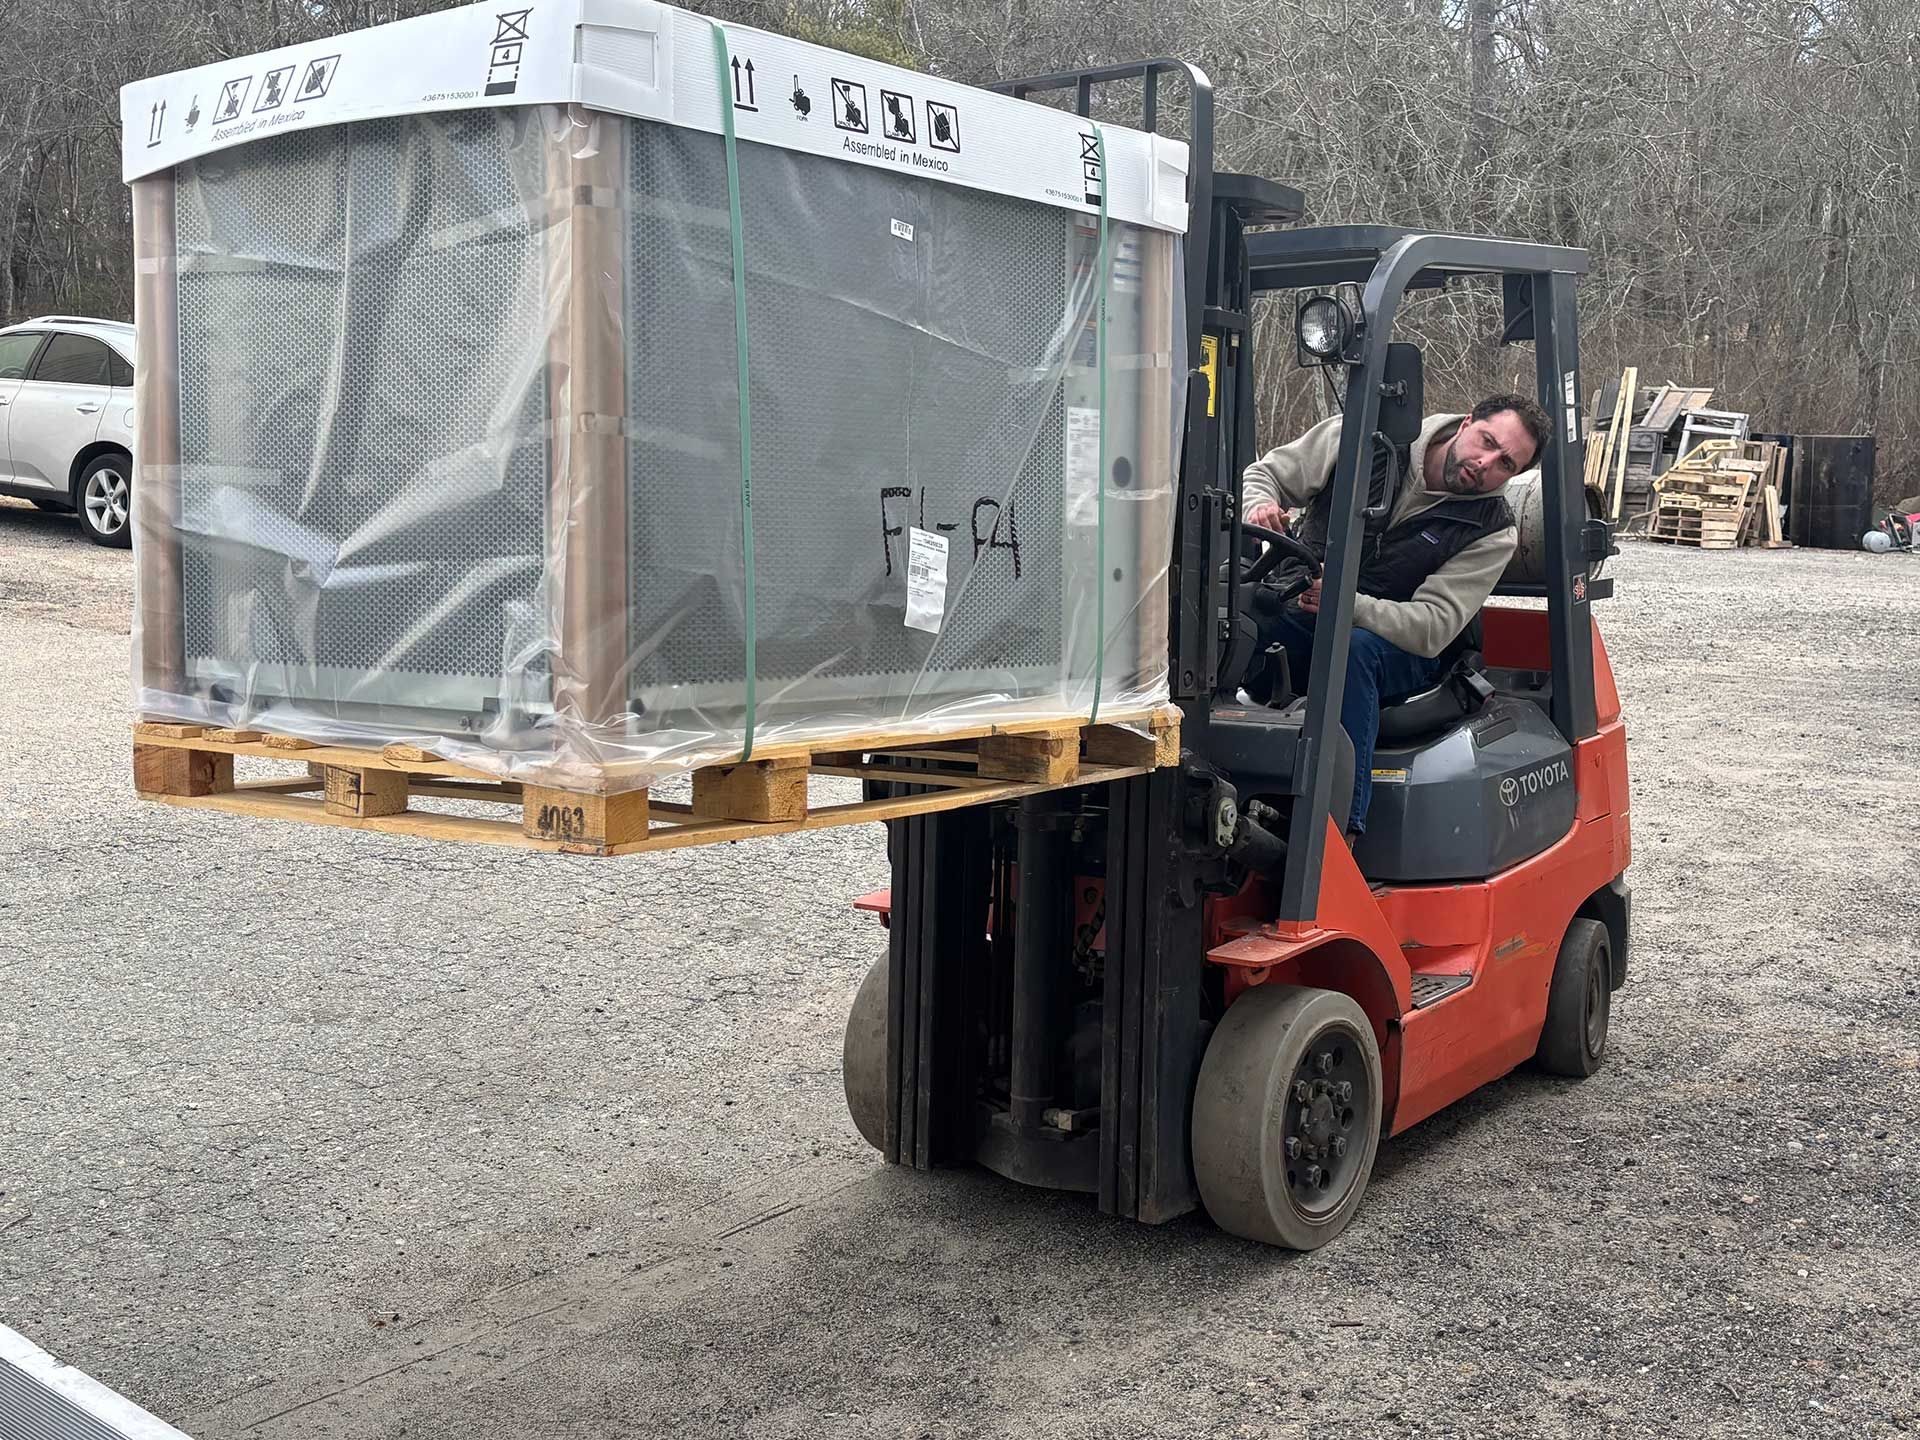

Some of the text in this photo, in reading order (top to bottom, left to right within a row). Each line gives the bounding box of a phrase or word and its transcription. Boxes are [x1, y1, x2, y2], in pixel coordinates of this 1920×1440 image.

[502, 48, 511, 60] 4
[421, 90, 479, 102] 436751530001
[211, 110, 306, 142] Assembled in Mexico
[842, 135, 949, 172] Assembled in Mexico
[1089, 166, 1097, 177] 4
[1519, 760, 1569, 797] TOYOTA
